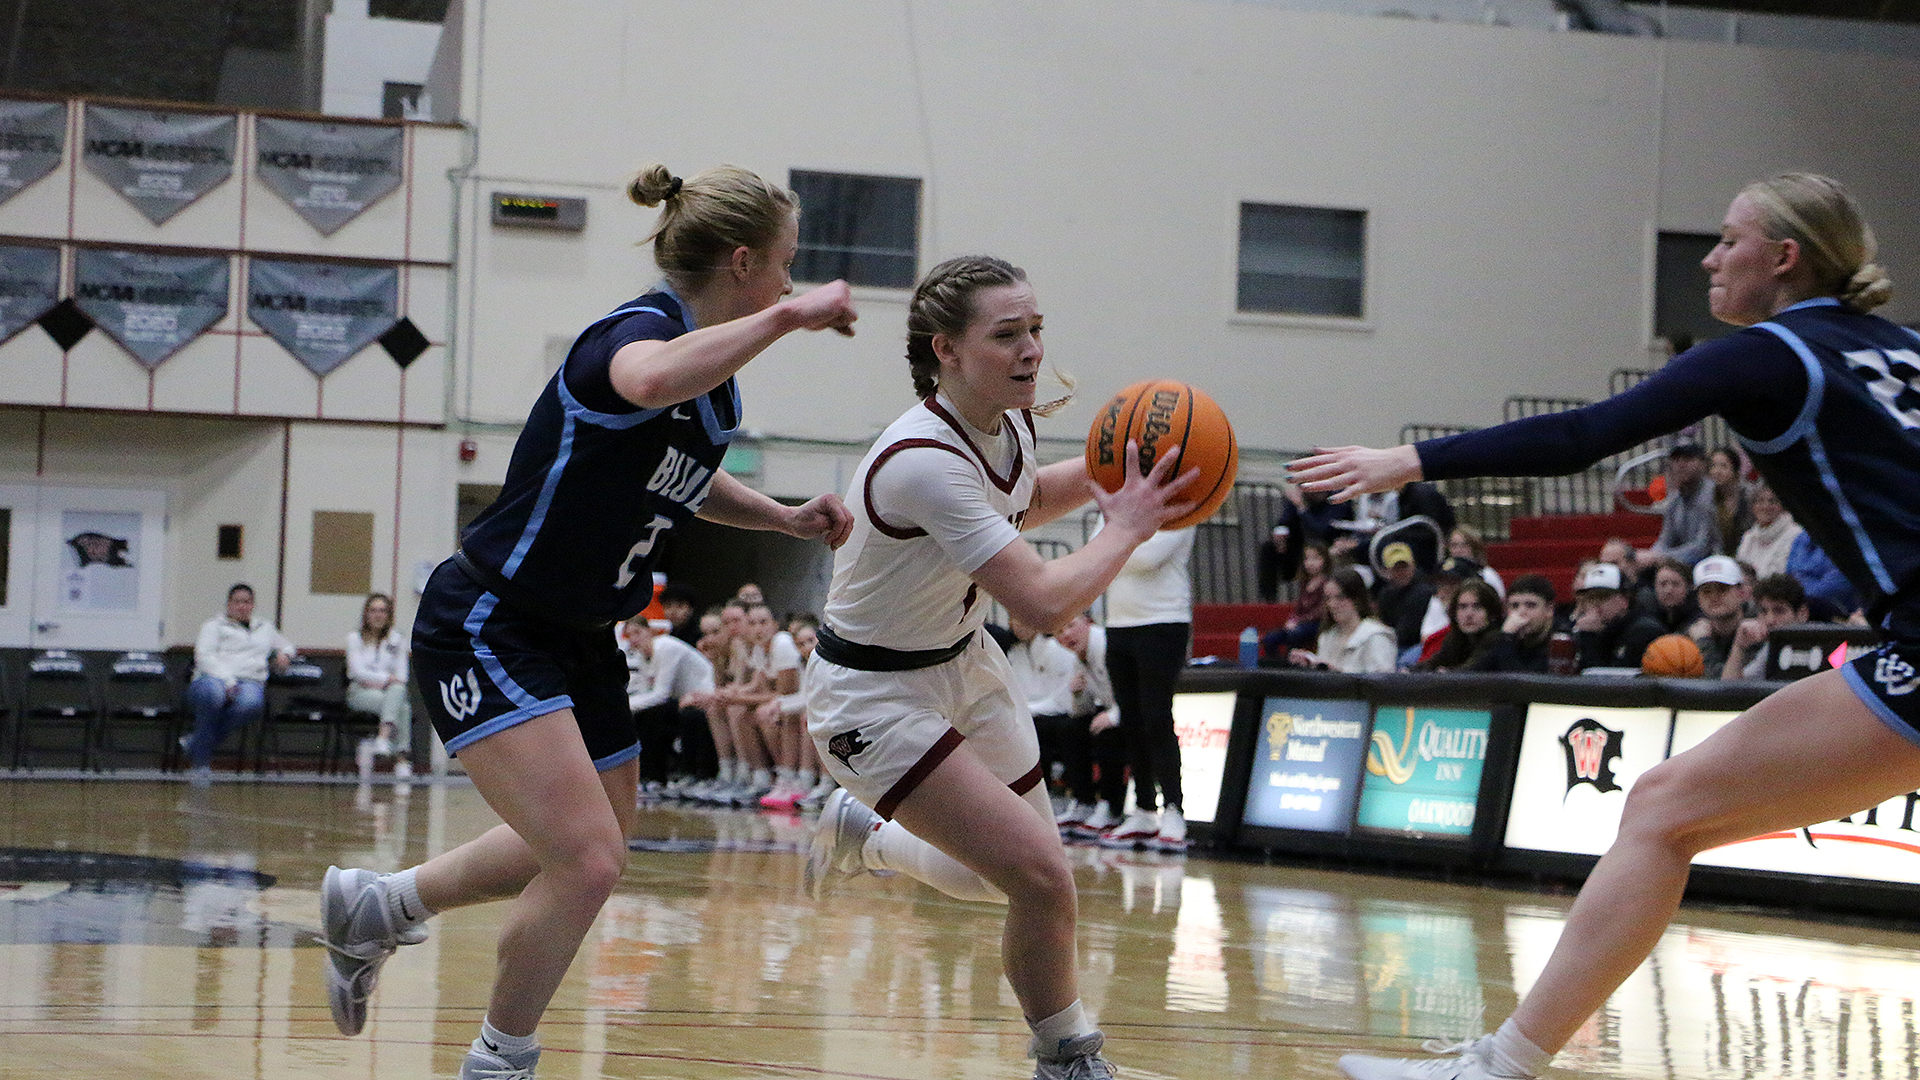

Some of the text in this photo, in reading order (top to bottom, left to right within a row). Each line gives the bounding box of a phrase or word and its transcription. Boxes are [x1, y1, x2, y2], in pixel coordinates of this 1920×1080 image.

[86, 140, 143, 157] NCAA
[79, 284, 134, 301] NCAA
[255, 294, 306, 312] NCAA
[613, 513, 674, 590] 2
[1290, 714, 1361, 738] Northwestern
[1286, 739, 1328, 762] Mutual
[1418, 719, 1488, 761] QUALITY
